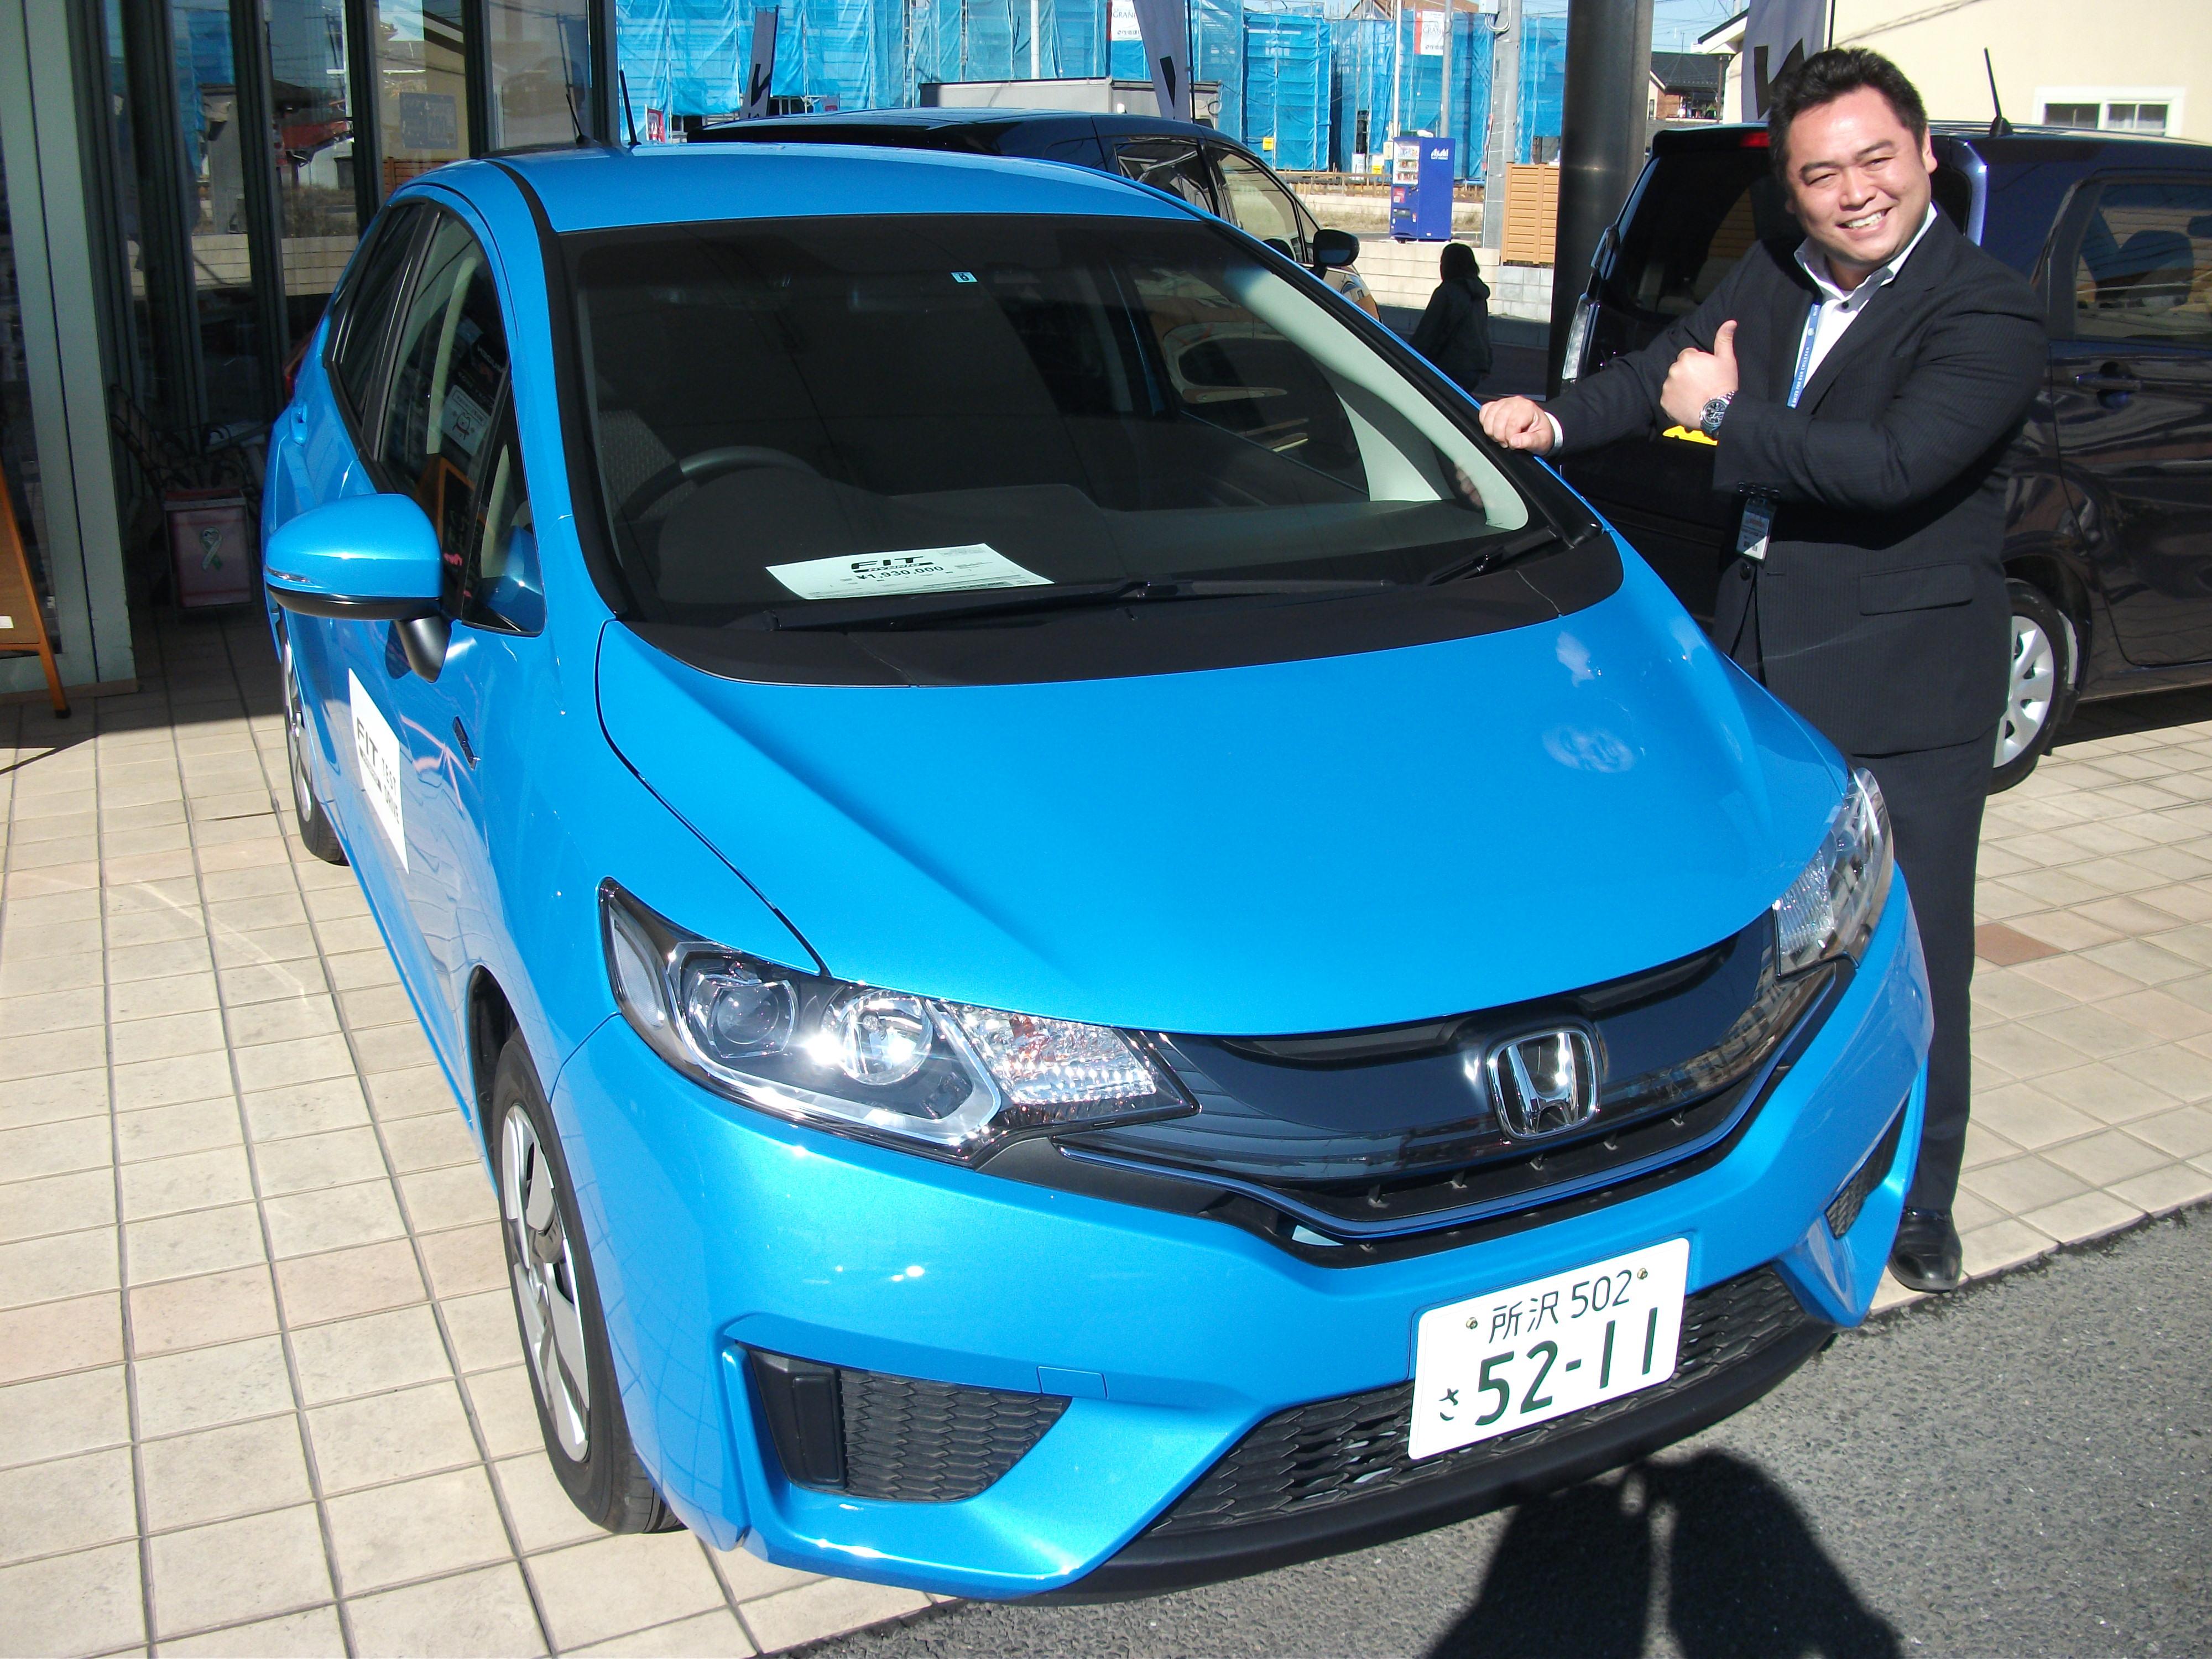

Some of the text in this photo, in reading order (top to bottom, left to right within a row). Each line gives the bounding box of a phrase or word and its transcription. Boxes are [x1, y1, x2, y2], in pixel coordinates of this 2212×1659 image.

[1801, 347, 1810, 371] CHILDREN
[851, 556, 924, 570] FIT
[856, 566, 944, 580] ¥1,930,000
[356, 716, 378, 767] FIT
[1489, 1269, 1632, 1343] 所沢 502
[1439, 1306, 1658, 1426] さ 52-11
